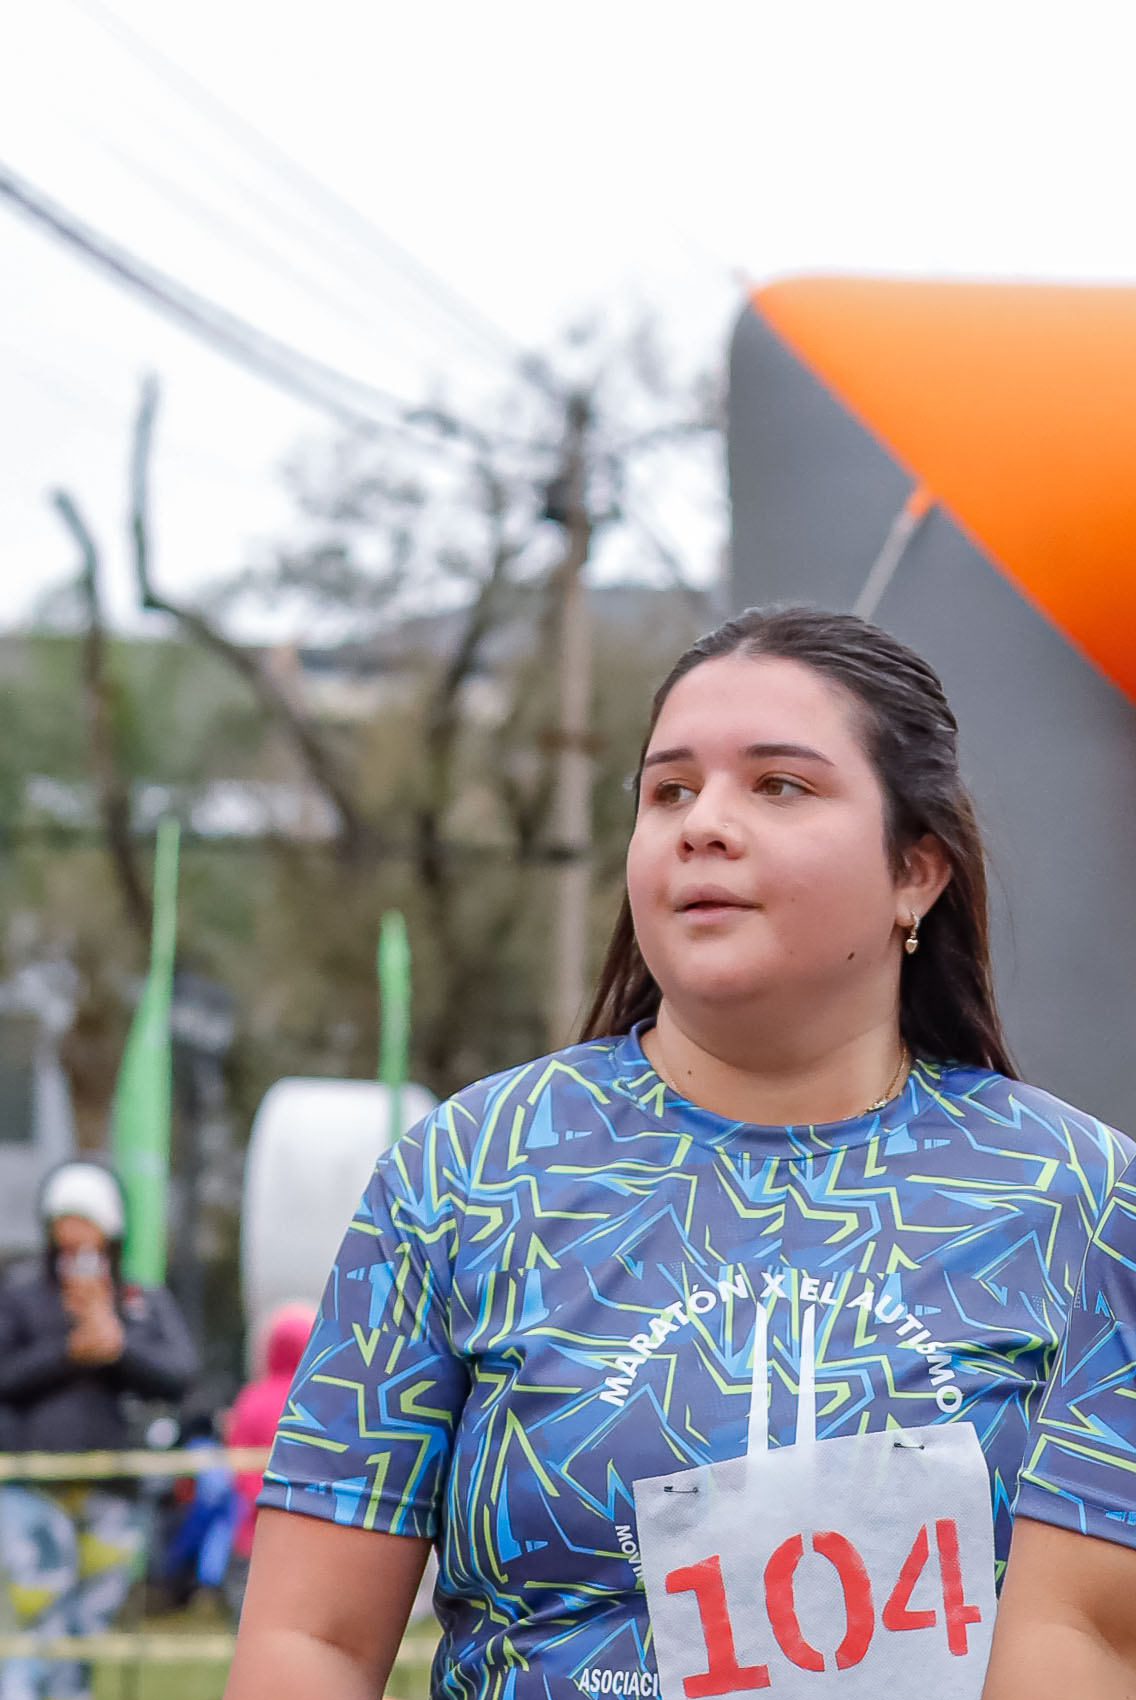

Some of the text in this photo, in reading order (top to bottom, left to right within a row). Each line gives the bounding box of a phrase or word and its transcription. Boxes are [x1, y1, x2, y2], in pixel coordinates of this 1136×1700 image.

[599, 1272, 963, 1413] MARATÓN X EL AUTISMO
[665, 1518, 981, 1698] 104
